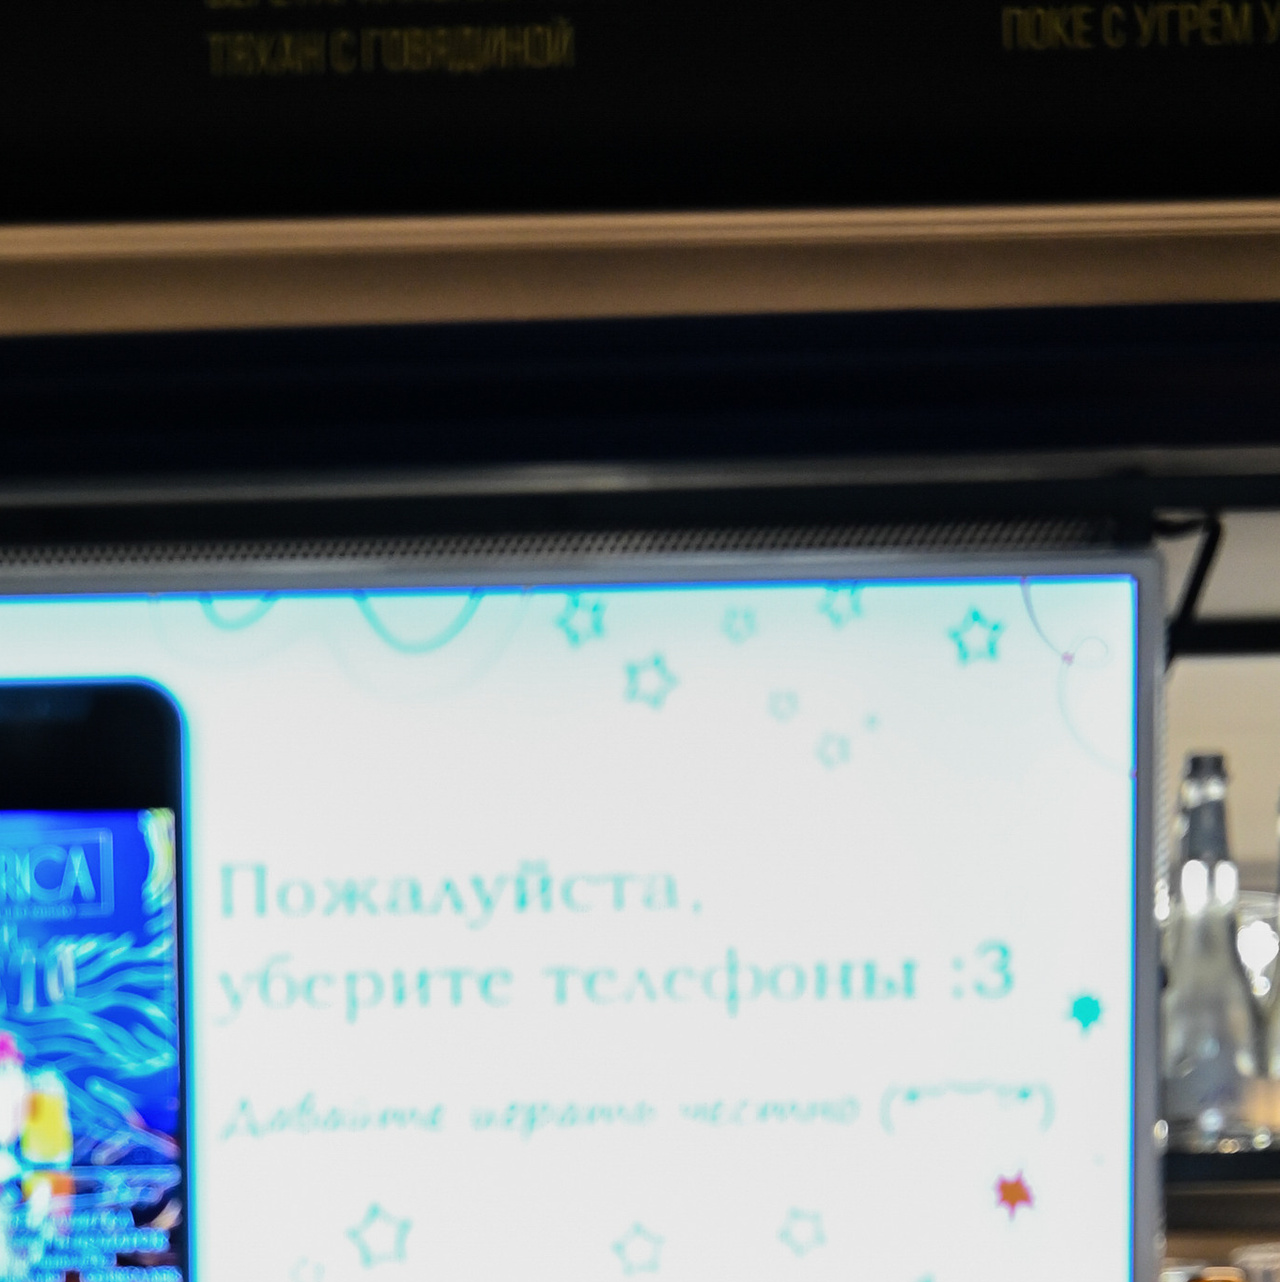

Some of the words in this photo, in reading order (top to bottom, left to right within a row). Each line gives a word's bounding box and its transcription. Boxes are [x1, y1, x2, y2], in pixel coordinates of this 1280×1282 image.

[220, 858, 702, 931] Пожалуйста,
[541, 944, 919, 1018] телефоны
[950, 937, 1015, 1001] :3
